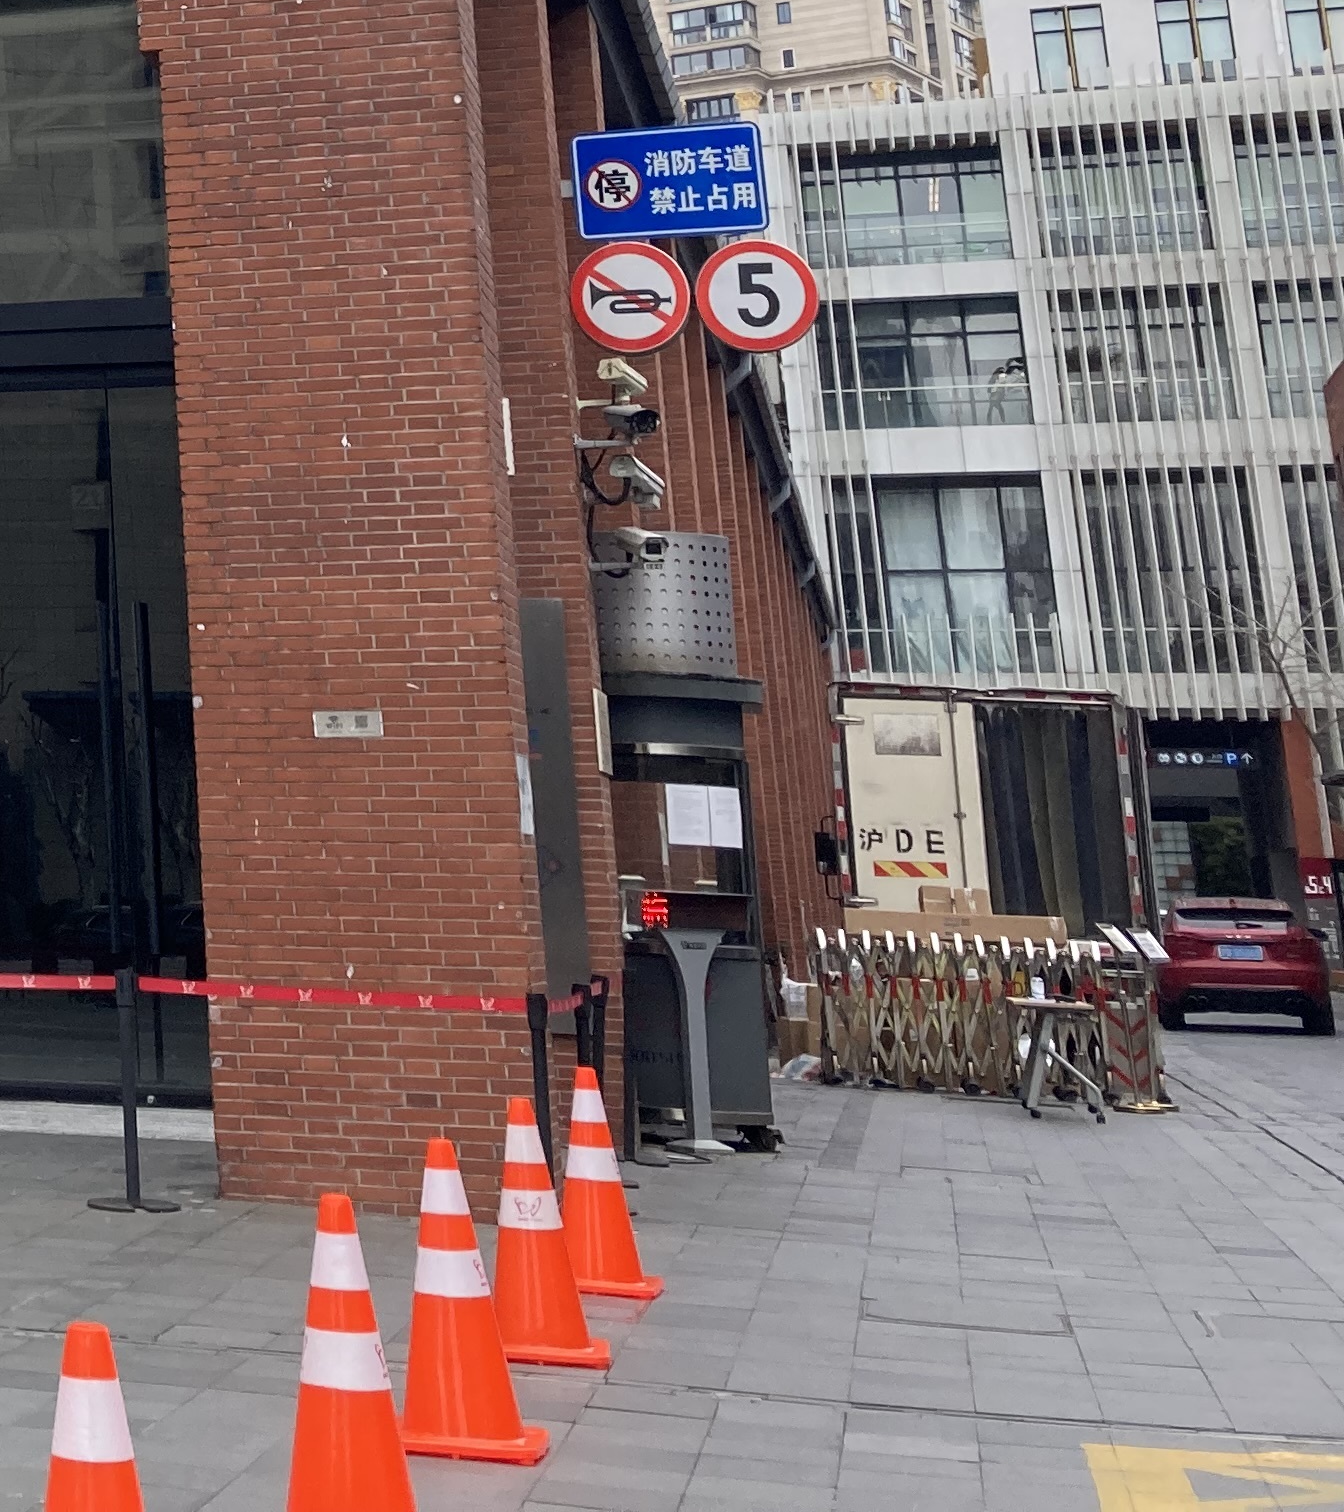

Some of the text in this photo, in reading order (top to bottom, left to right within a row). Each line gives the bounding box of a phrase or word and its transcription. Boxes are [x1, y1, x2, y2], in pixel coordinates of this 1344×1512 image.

[644, 144, 753, 178] 消防车道
[593, 169, 632, 204] 停
[649, 182, 758, 215] 禁止占用
[737, 262, 780, 328] 5
